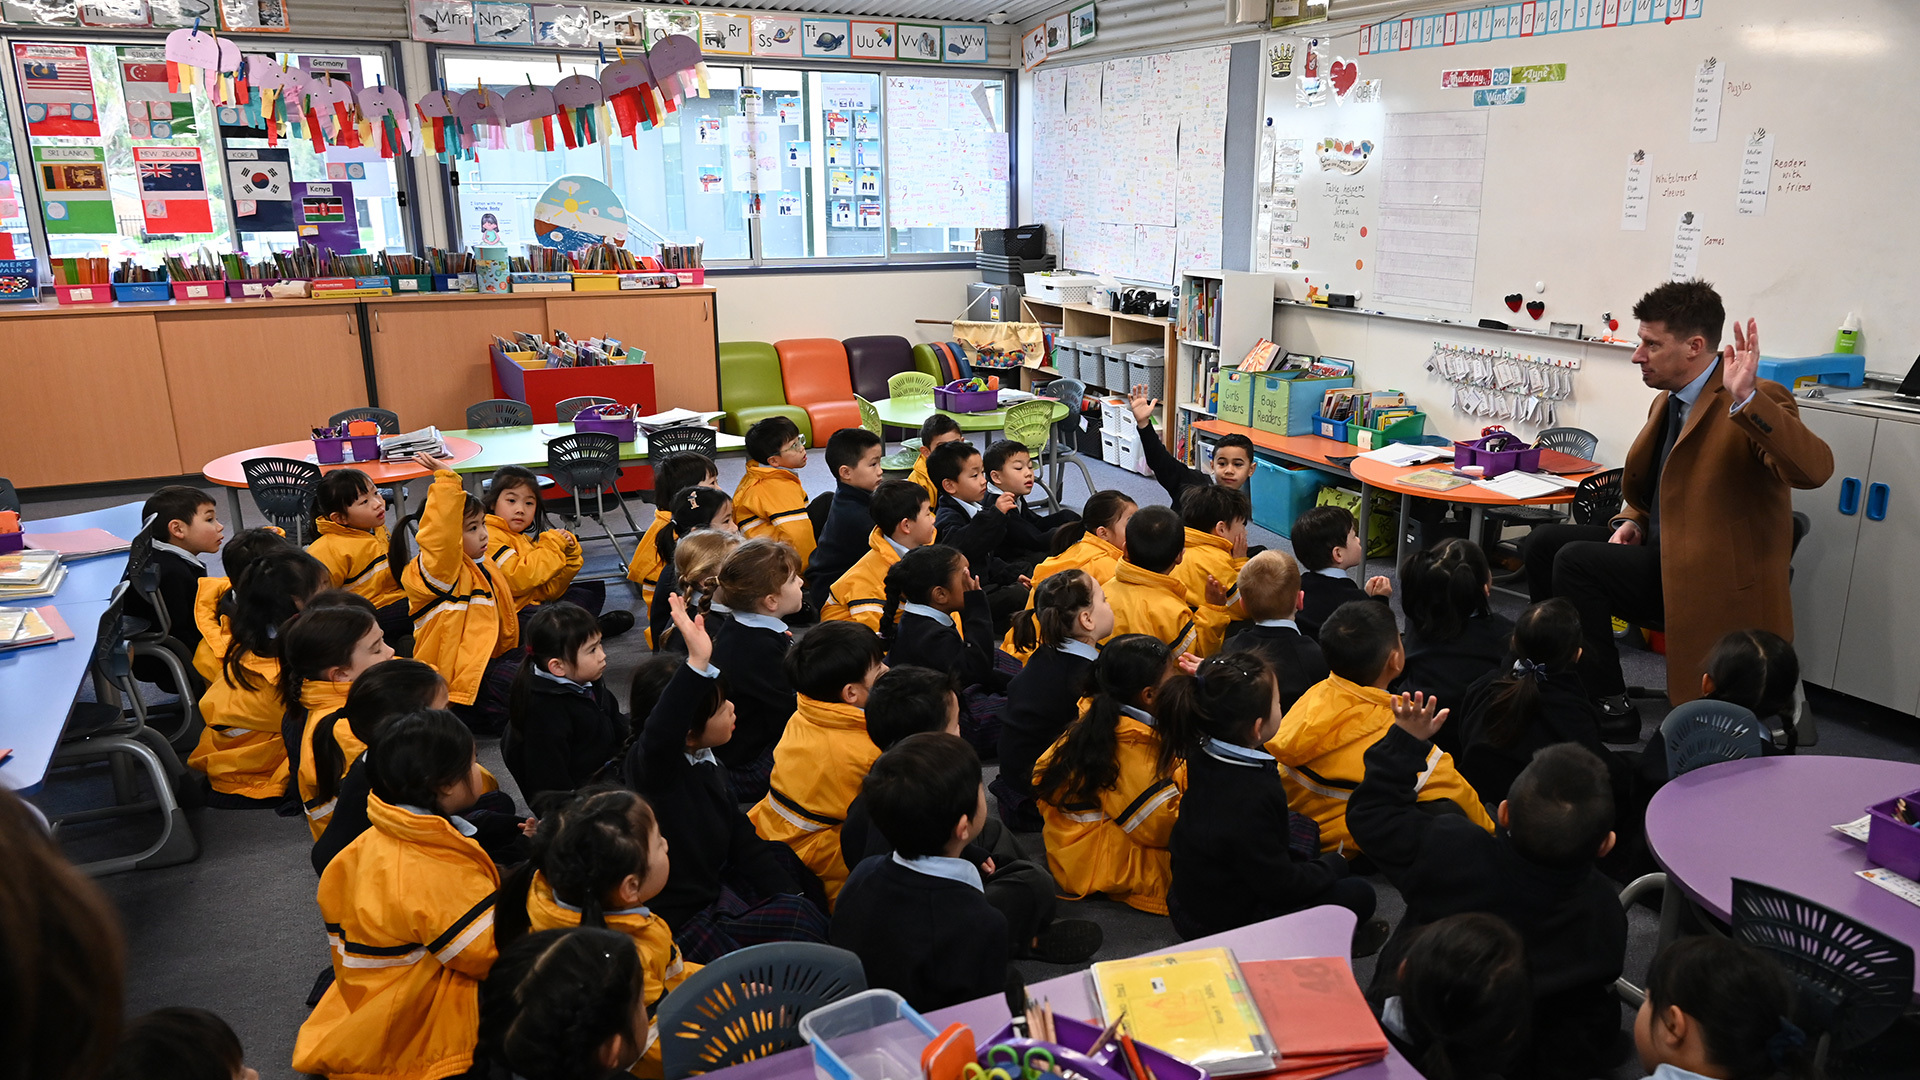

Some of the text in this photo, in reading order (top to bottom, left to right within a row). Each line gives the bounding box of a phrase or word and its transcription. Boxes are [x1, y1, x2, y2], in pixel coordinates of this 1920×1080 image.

[435, 10, 467, 25] Mm
[479, 12, 502, 26] Nn
[1072, 15, 1080, 29] Zz
[728, 24, 742, 38] Rr
[805, 25, 816, 39] Tt
[758, 34, 773, 48] Ss
[857, 36, 874, 48] Uu
[901, 35, 918, 47] Vv
[960, 34, 984, 47] Ww
[312, 59, 344, 68] Germany
[1449, 72, 1484, 86] Thursday
[1494, 73, 1504, 82] 20
[1526, 69, 1548, 80] June
[63, 149, 89, 157] LANKA
[1774, 158, 1807, 169] Readers
[1782, 168, 1802, 179] with
[1786, 182, 1811, 194] friend
[1225, 388, 1239, 401] Girls
[1222, 400, 1244, 415] Readers
[1260, 394, 1277, 413] Boys
[1257, 410, 1282, 426] Readers
